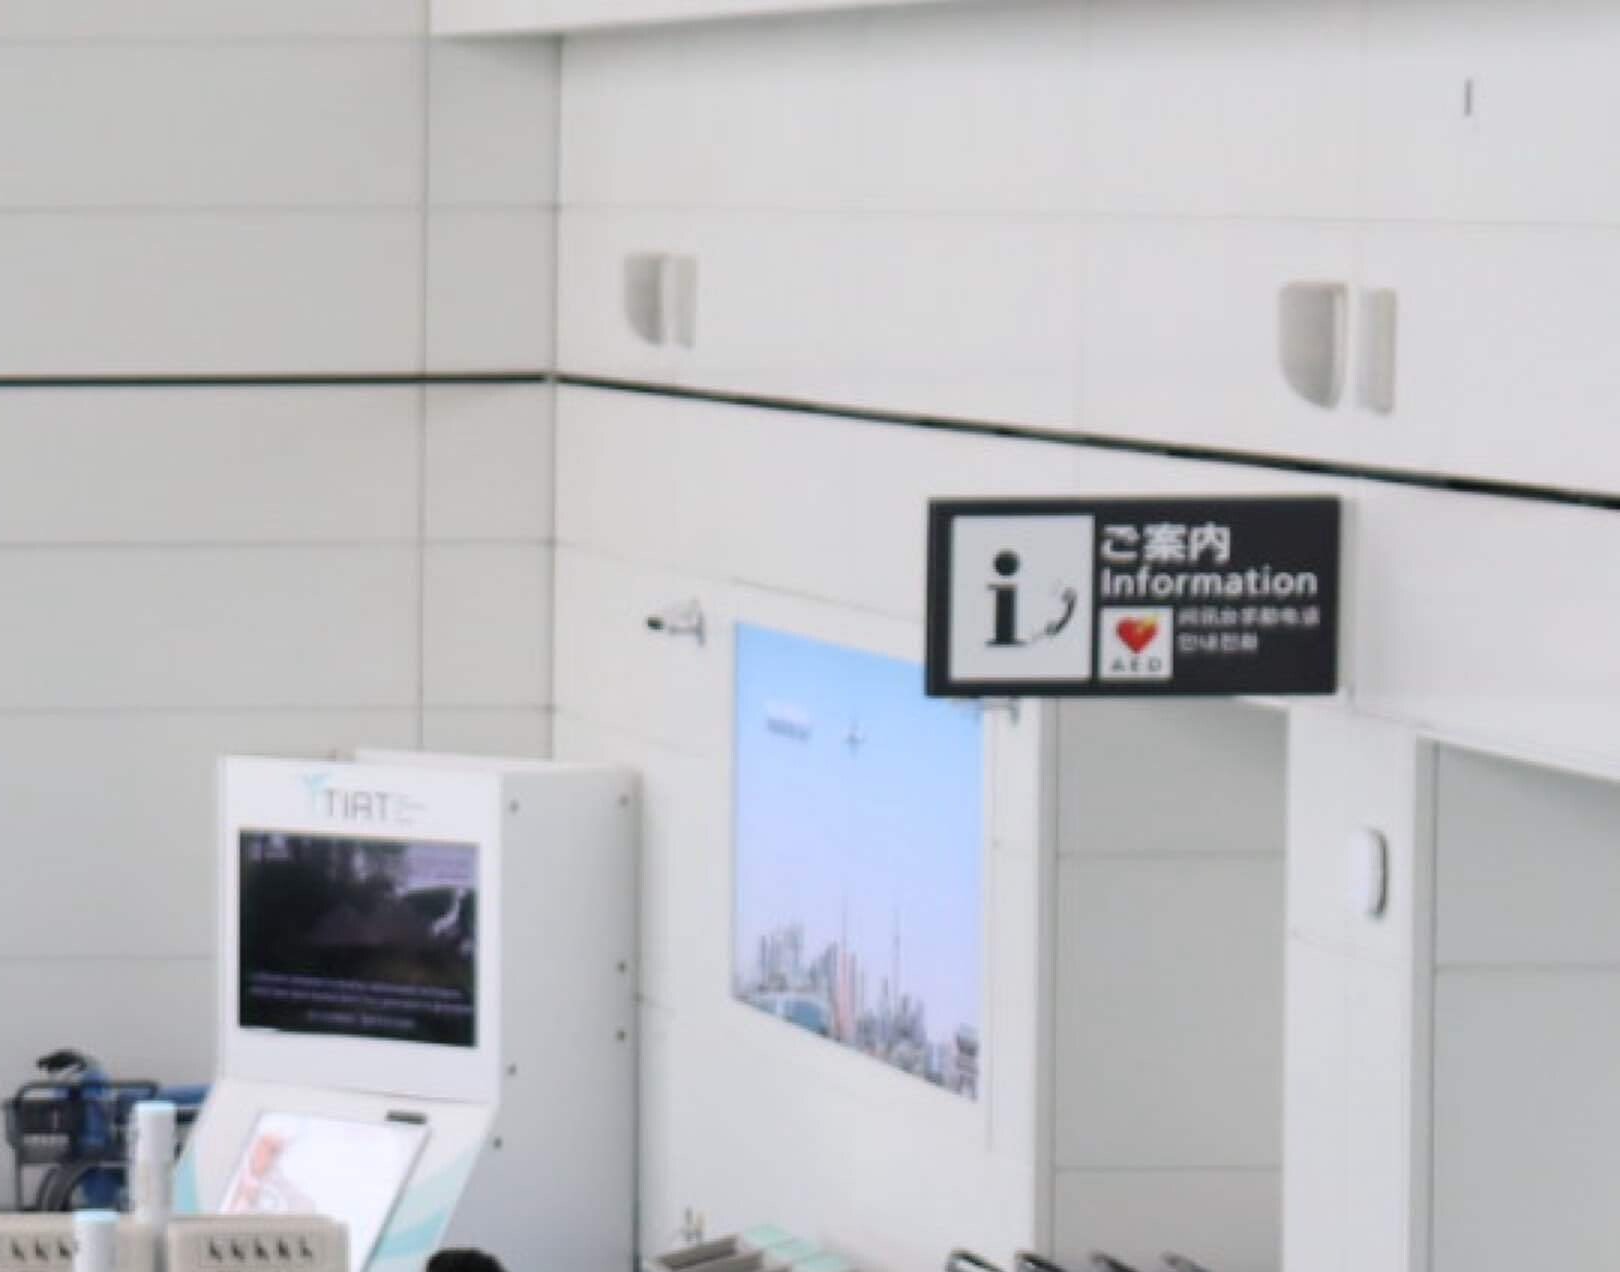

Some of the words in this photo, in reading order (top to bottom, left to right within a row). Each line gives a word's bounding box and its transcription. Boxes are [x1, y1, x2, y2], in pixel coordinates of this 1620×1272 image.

[1100, 522, 1231, 564] ご案内
[1101, 564, 1319, 598] Information
[1111, 655, 1164, 673] AED
